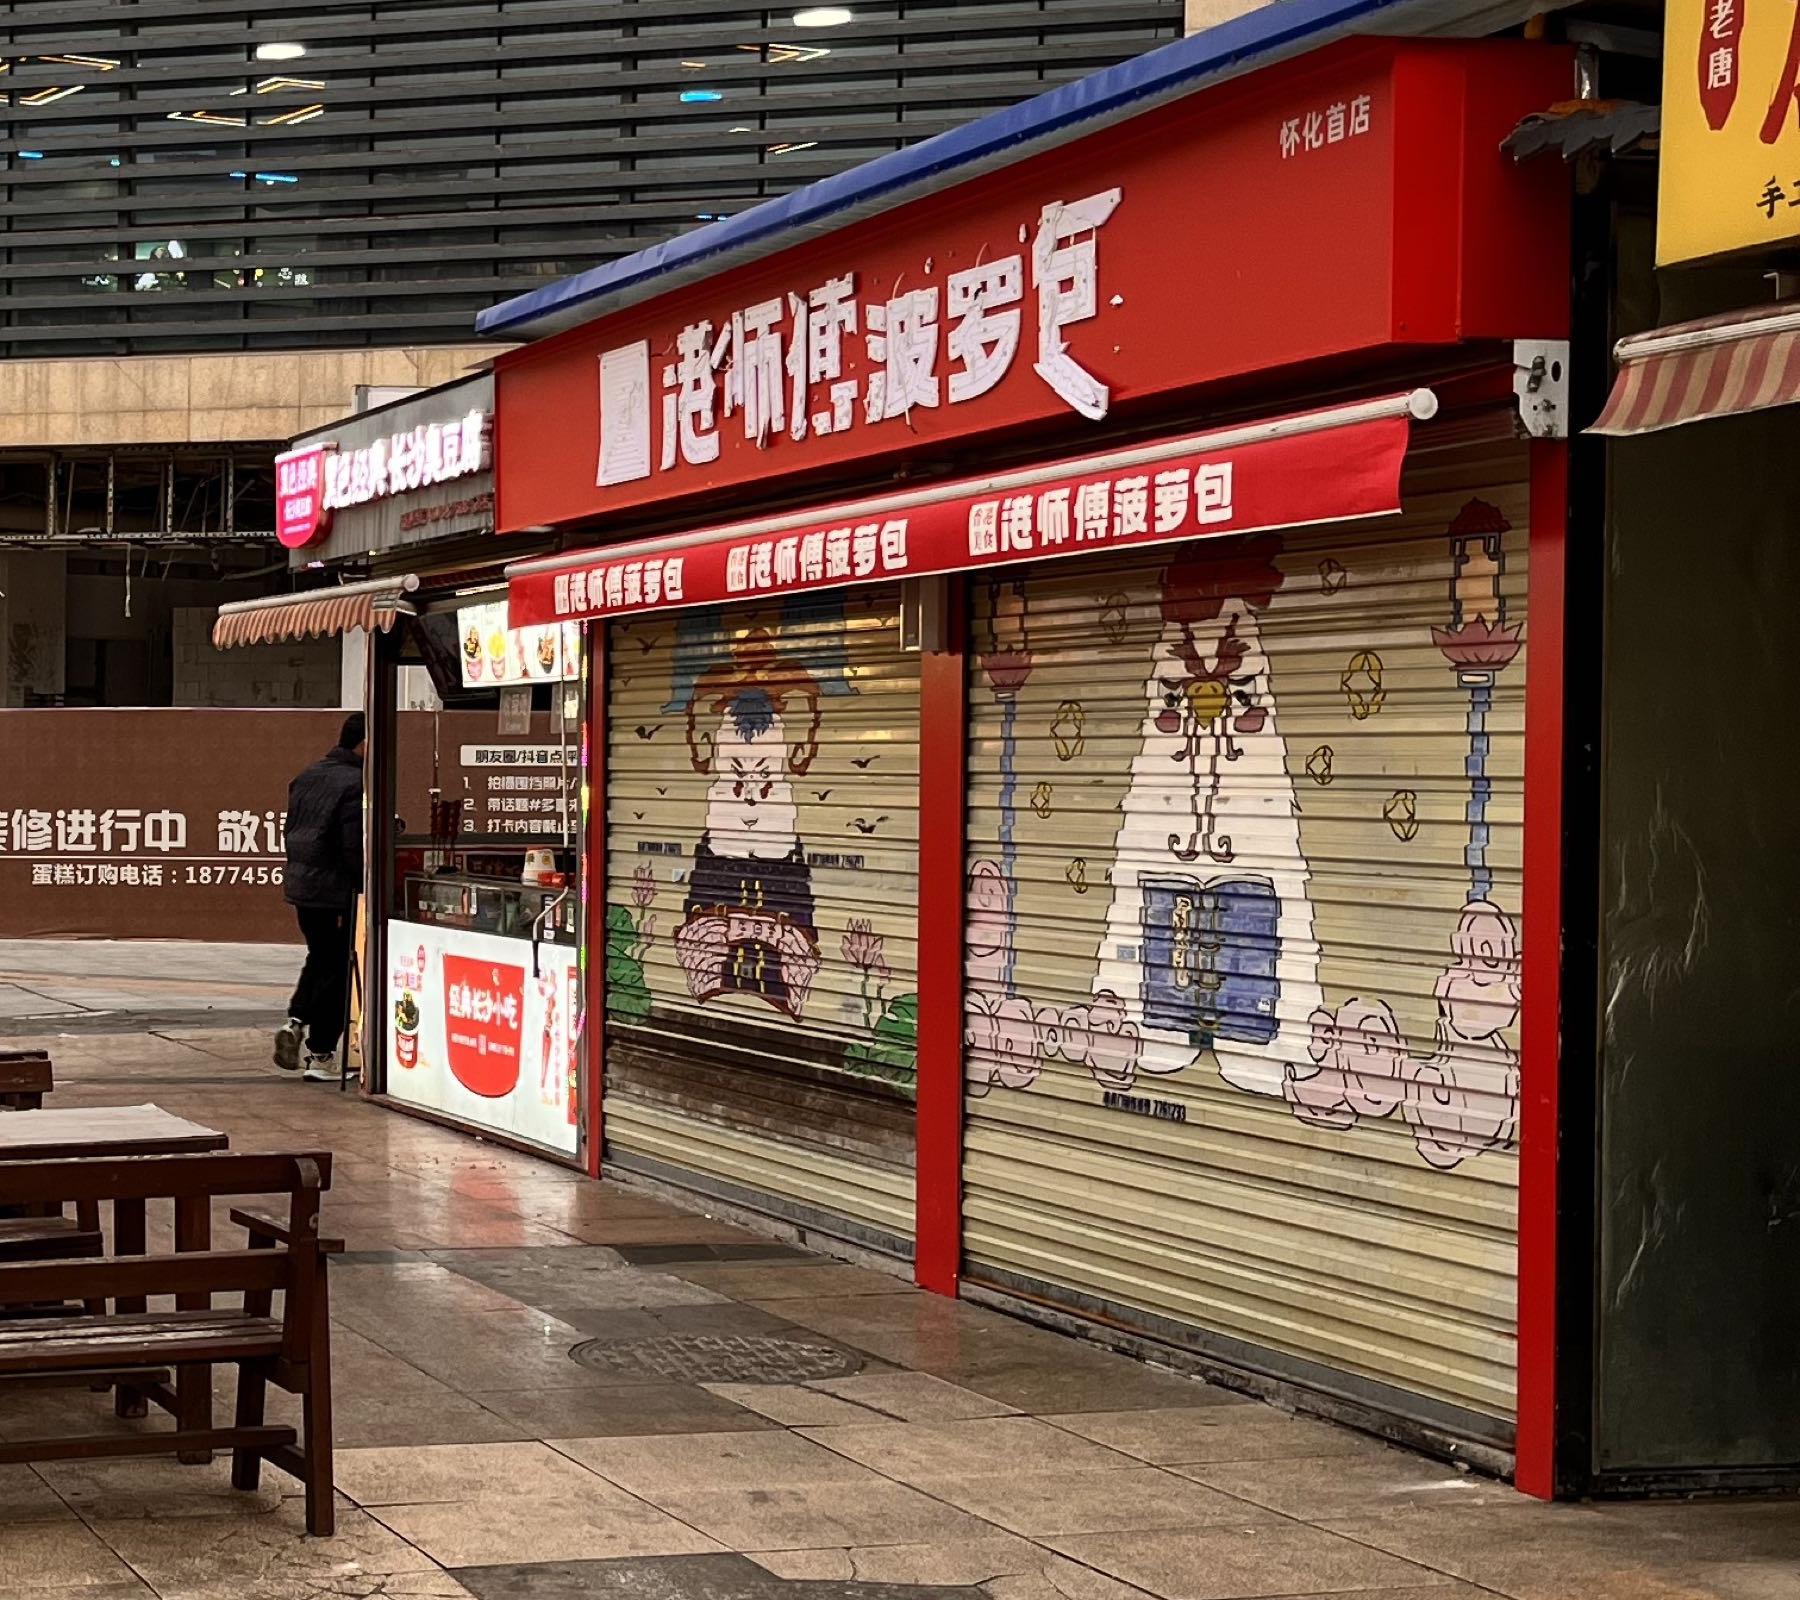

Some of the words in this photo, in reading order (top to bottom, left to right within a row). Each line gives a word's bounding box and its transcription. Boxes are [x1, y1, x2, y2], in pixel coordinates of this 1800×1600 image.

[1279, 94, 1371, 160] 怀化首店
[1000, 461, 1233, 552] 港师傅菠萝包
[749, 518, 910, 589] 港师傅菠萝包
